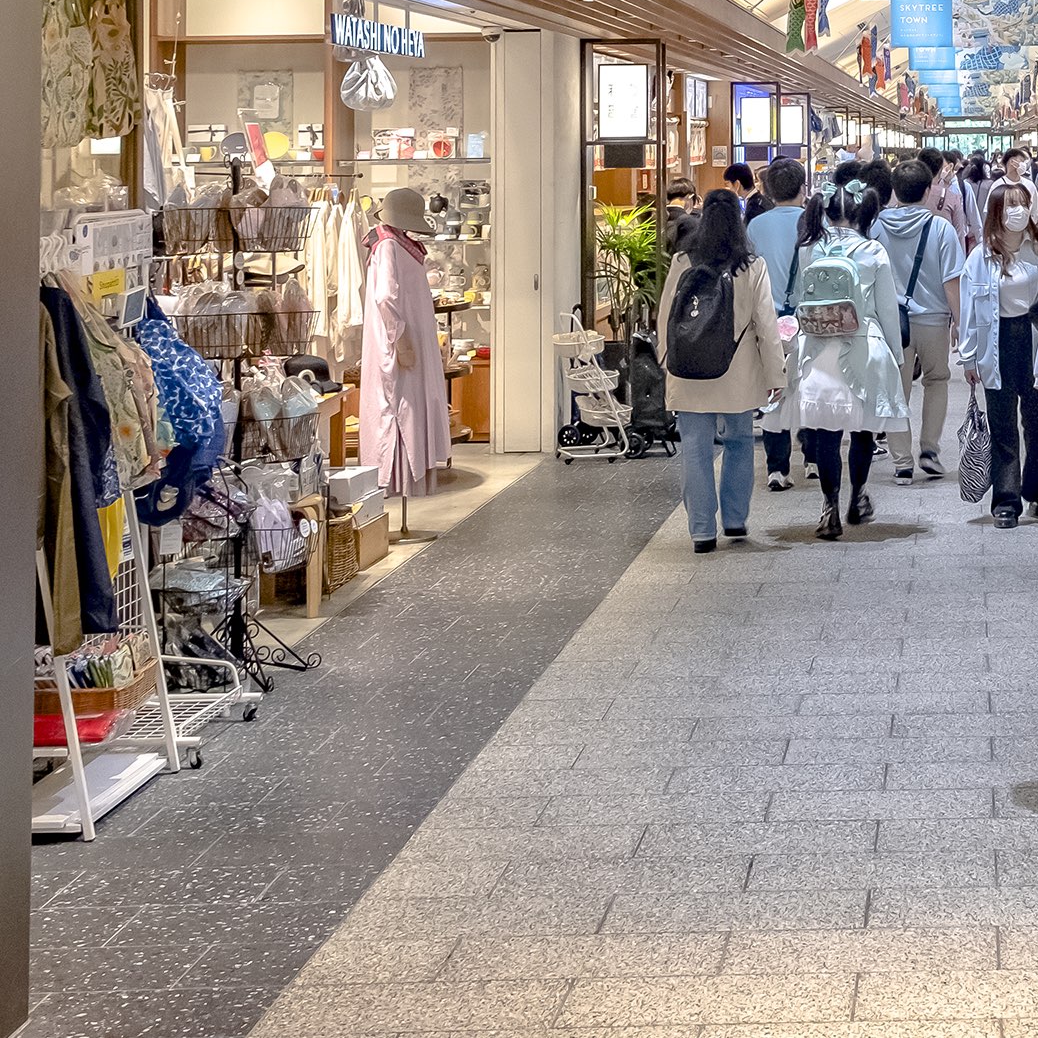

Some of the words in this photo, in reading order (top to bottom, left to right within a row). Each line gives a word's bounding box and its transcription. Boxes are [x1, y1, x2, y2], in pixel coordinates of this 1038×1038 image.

[899, 4, 944, 12] SKYTREE
[900, 16, 928, 24] TOWN
[334, 13, 381, 51] WATASHI
[383, 24, 400, 54] NO
[400, 27, 425, 58] HEYA
